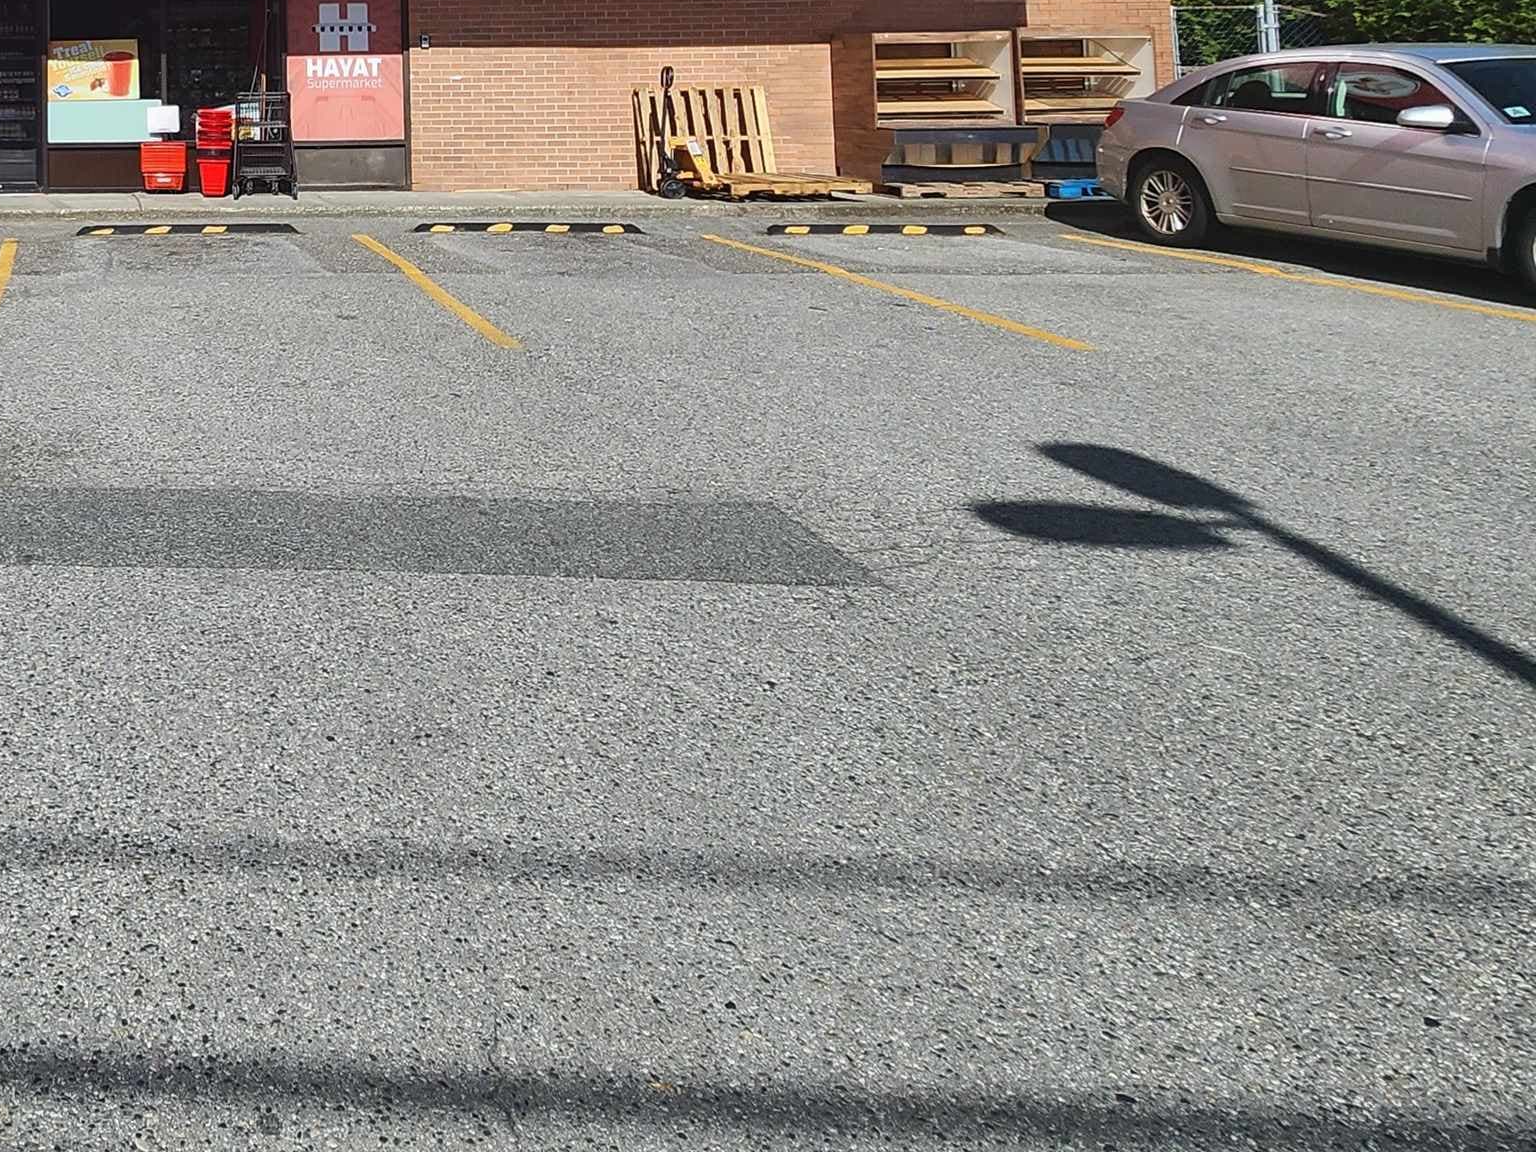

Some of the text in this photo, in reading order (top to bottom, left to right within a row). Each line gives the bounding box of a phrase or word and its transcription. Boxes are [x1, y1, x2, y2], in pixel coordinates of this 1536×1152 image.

[53, 40, 93, 59] Treat
[306, 56, 382, 78] HAYAT
[307, 78, 384, 92] Supermarket
